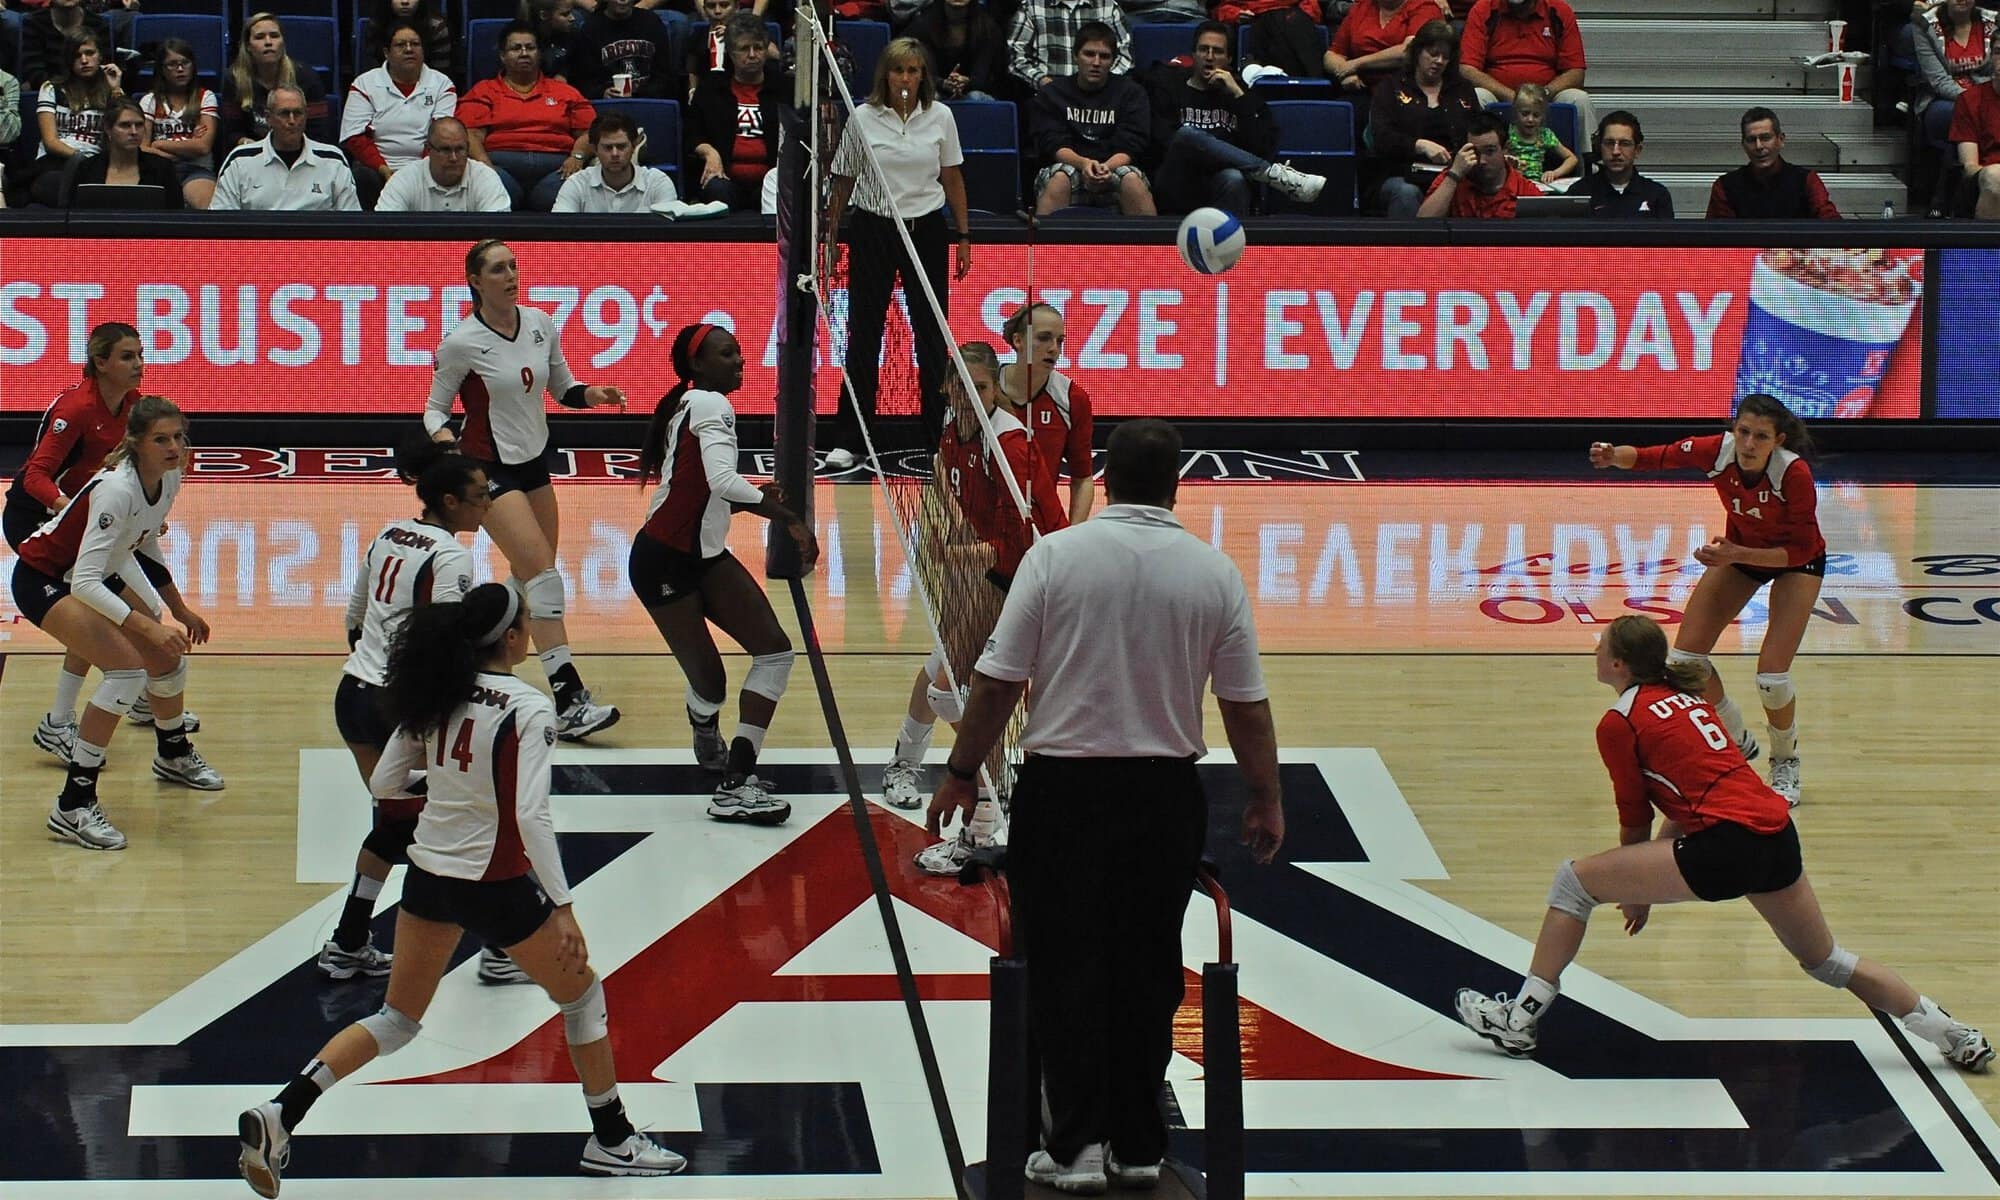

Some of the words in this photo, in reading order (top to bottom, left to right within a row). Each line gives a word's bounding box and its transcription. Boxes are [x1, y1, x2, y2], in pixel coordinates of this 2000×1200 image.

[1066, 106, 1115, 124] ARIZONA
[0, 281, 105, 365] ST
[1263, 289, 1734, 371] EVERYDAY
[521, 367, 534, 393] 9
[1041, 411, 1051, 424] U
[183, 446, 660, 479] BER
[1758, 491, 1769, 503] U
[375, 555, 404, 604] 11
[1479, 596, 1860, 625] OLSN
[436, 717, 475, 773] 14
[1689, 708, 1728, 751] 6
